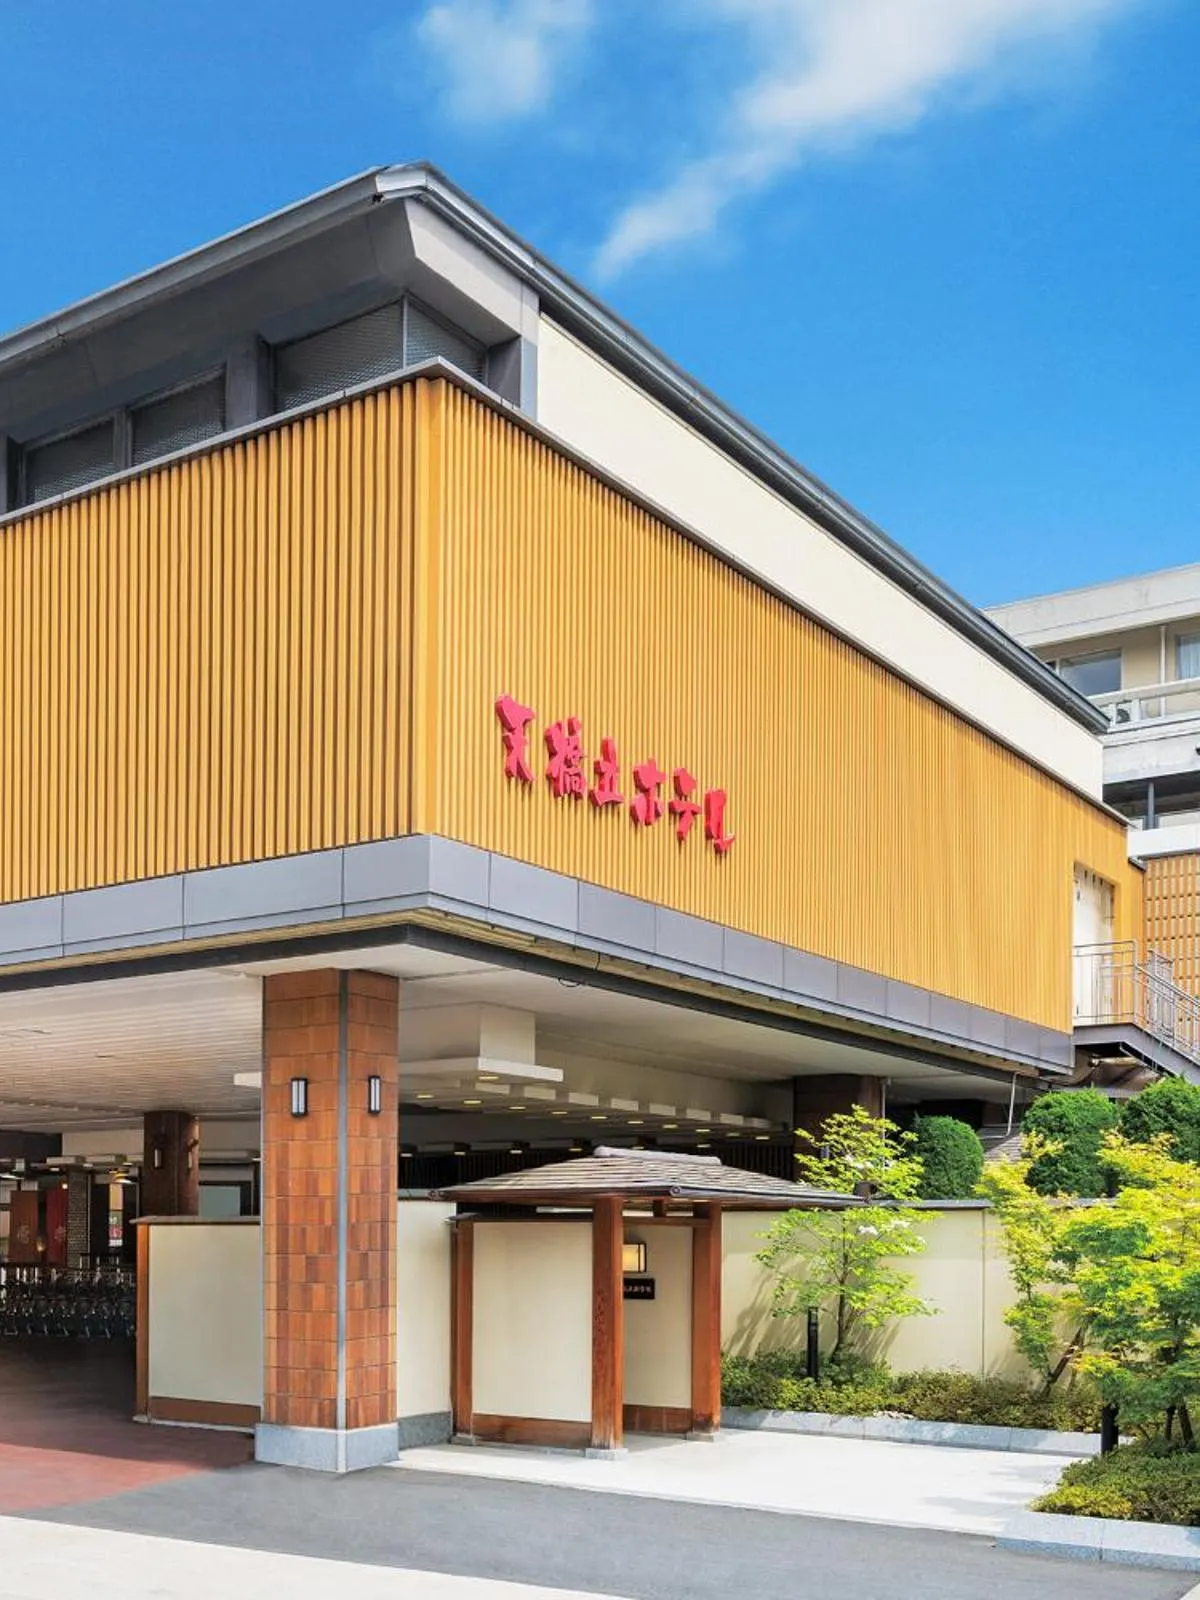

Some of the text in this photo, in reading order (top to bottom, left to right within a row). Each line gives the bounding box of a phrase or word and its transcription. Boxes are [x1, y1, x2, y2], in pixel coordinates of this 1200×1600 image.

[495, 693, 735, 854] 天橋立ホテル
